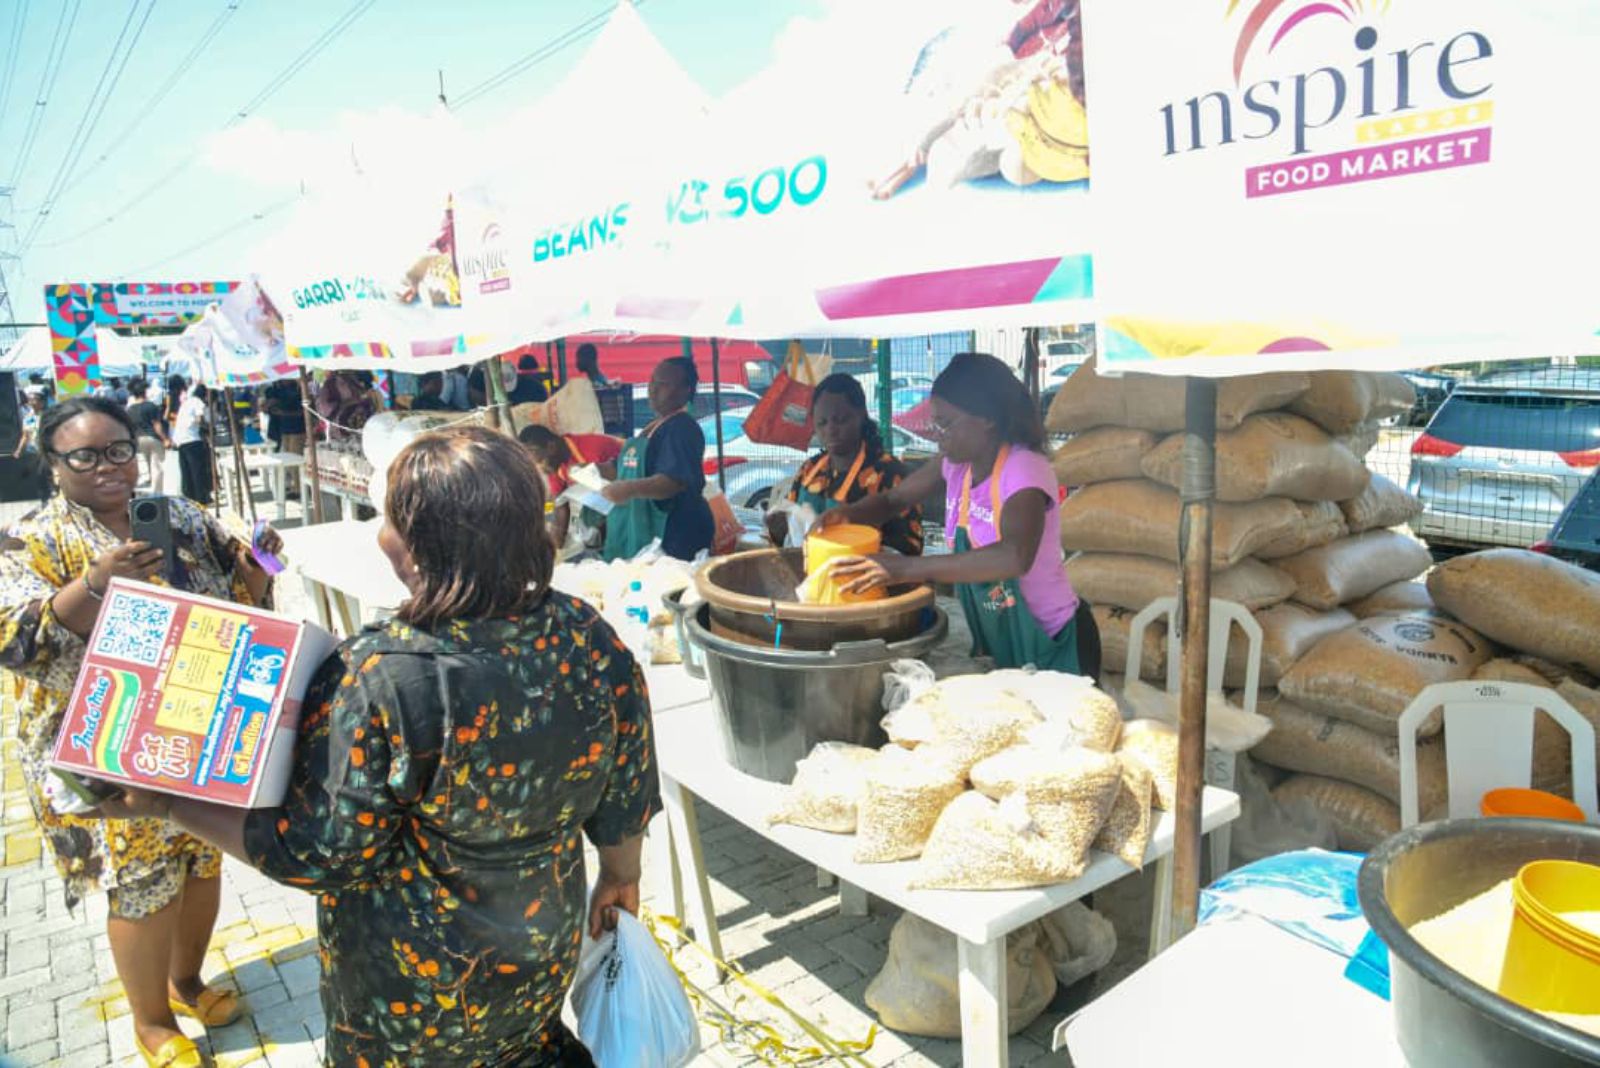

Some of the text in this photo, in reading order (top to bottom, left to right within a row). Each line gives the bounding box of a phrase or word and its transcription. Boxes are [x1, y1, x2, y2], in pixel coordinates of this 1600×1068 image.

[1159, 26, 1494, 157] inspire
[1257, 135, 1480, 192] FOOD MARKET
[533, 201, 631, 262] BEANS
[292, 277, 345, 310] GARRI
[135, 733, 162, 776] Eat
[162, 736, 189, 778] Win
